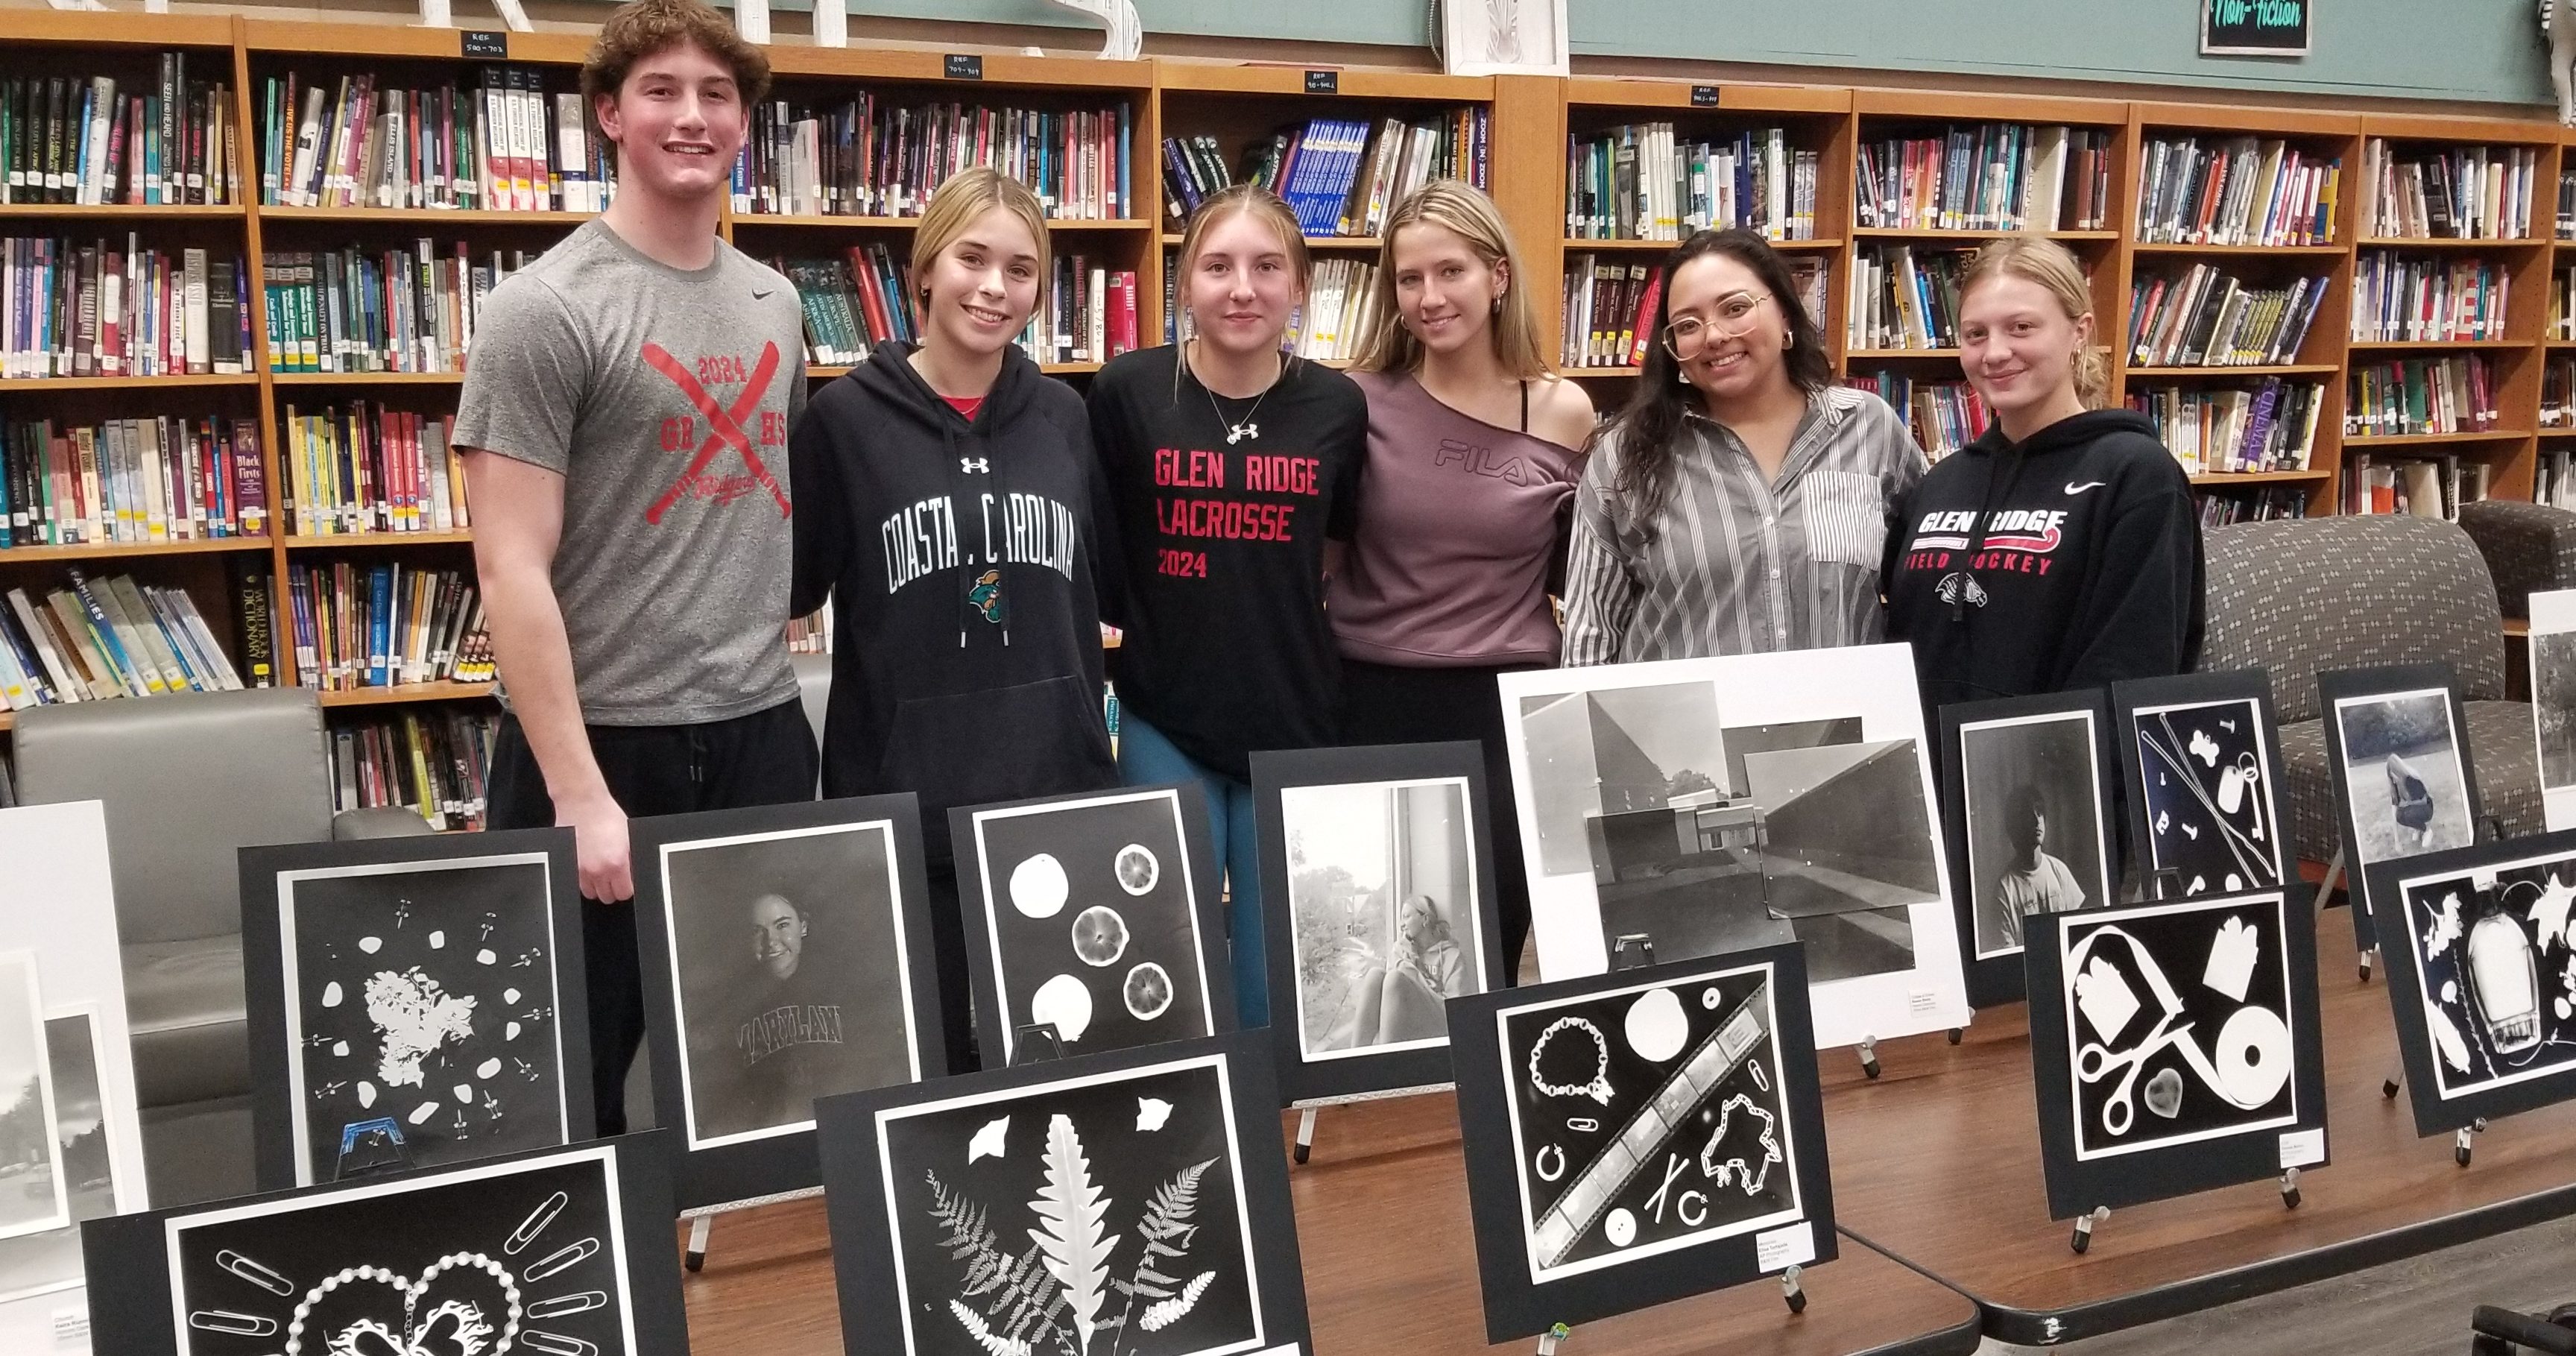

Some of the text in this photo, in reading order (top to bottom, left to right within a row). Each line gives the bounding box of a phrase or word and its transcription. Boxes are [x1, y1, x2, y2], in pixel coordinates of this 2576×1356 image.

[163, 83, 172, 101] SEEN
[162, 113, 171, 137] HEARD
[285, 123, 294, 135] US
[284, 151, 292, 175] VOTE!
[387, 145, 395, 172] ISLAND
[1166, 270, 1174, 295] SCIENCE
[802, 303, 812, 321] ASIA
[807, 297, 821, 326] AFRICA
[827, 295, 842, 328] EUROPE
[835, 293, 852, 332] AUSTRALIA
[321, 323, 327, 334] ON
[698, 355, 748, 385] 2024
[660, 416, 695, 451] GR
[2250, 391, 2276, 448] CINEMA
[236, 455, 259, 467] Black
[238, 467, 261, 479] Firsts
[1155, 448, 1319, 496] GLEN RIDGE
[1435, 438, 1529, 487] FILA
[1157, 497, 1295, 542] LACROSSE
[1918, 511, 1977, 533] GLEN
[882, 495, 973, 594] COASTA
[1158, 549, 1208, 578] 2024
[1969, 552, 2052, 575] OCKEY
[70, 570, 104, 621] FAMILIES
[243, 589, 261, 659] DICTIONARY
[254, 589, 270, 659] WORLD BOOK
